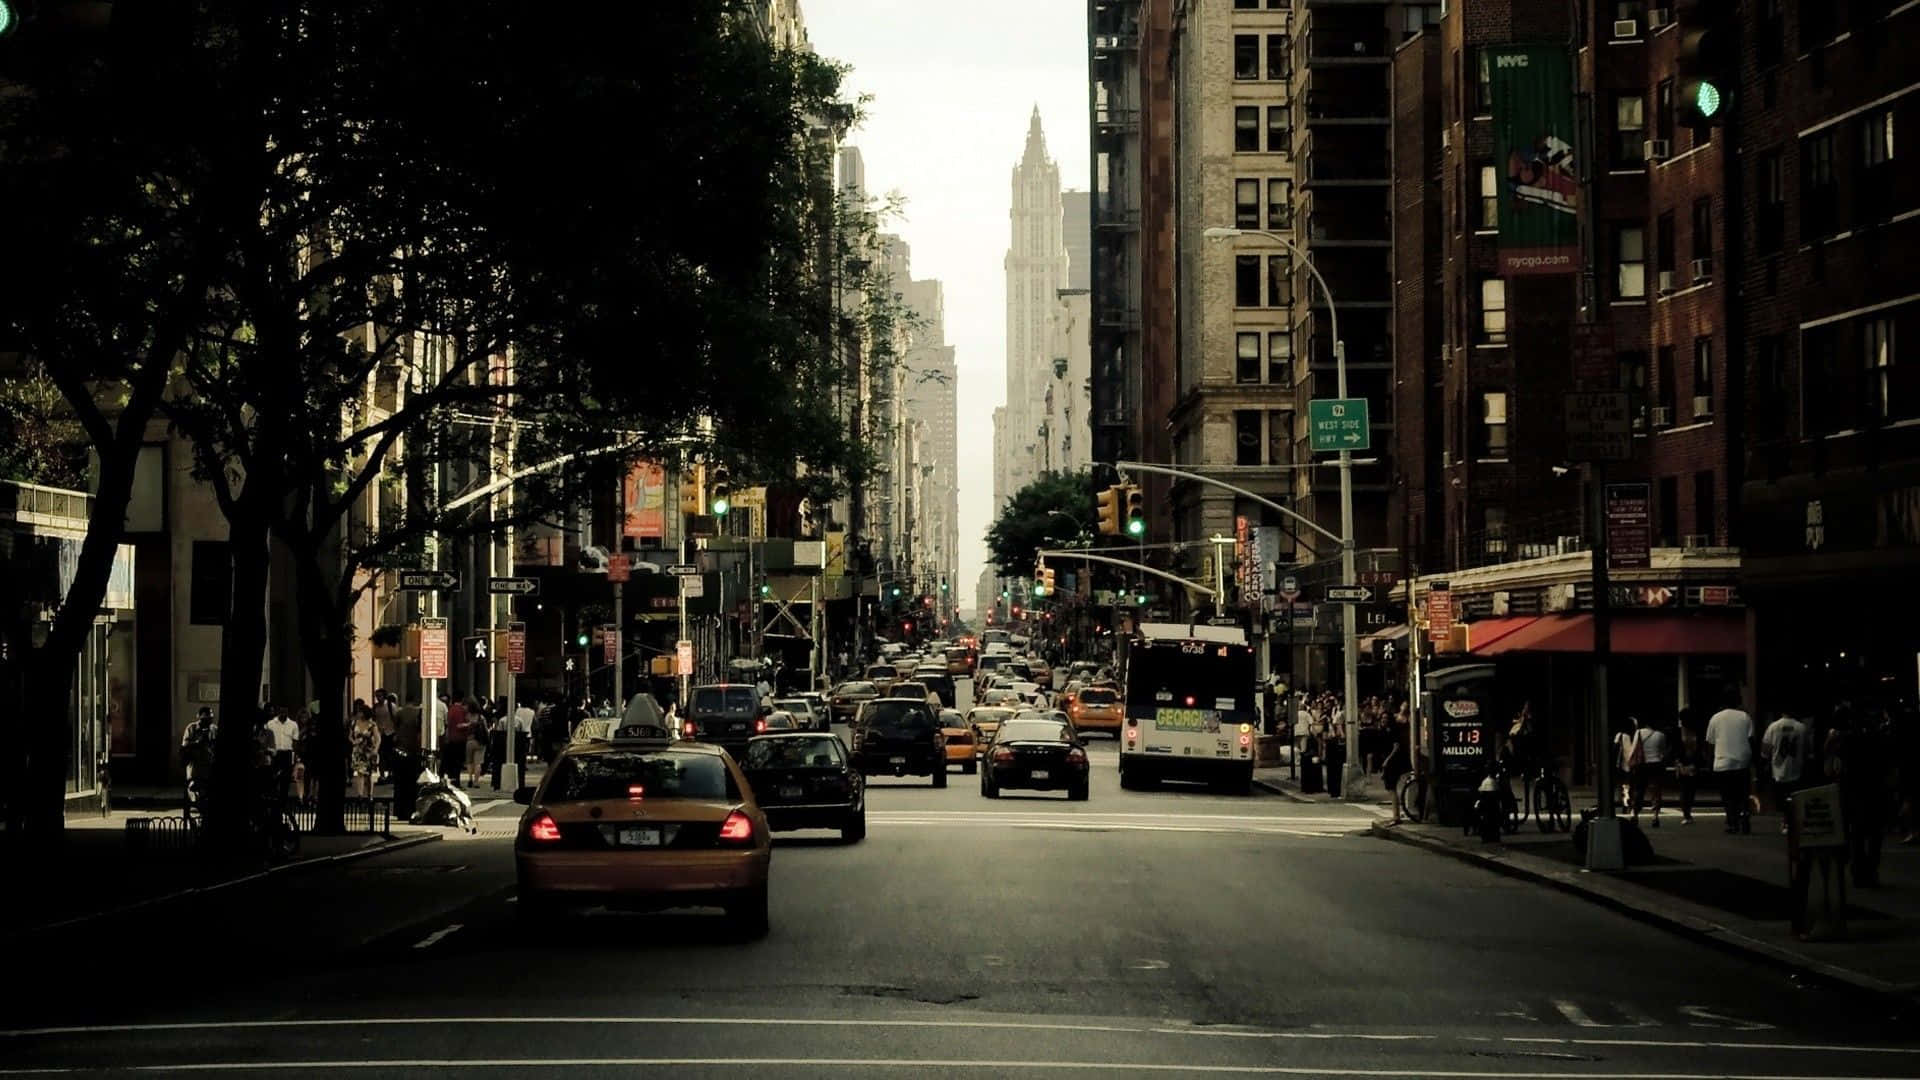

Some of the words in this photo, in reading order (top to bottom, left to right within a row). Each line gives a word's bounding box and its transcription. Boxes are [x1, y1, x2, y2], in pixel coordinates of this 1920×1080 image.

[1496, 55, 1529, 68] NYC
[1508, 255, 1569, 267] nycgo.com
[1318, 420, 1338, 430] WEST
[1341, 419, 1360, 429] SIDE
[1319, 434, 1336, 443] HWY
[408, 576, 424, 585] ONE
[1182, 645, 1205, 654] 6738
[1458, 730, 1480, 743] 113
[1441, 746, 1483, 756] MILLION
